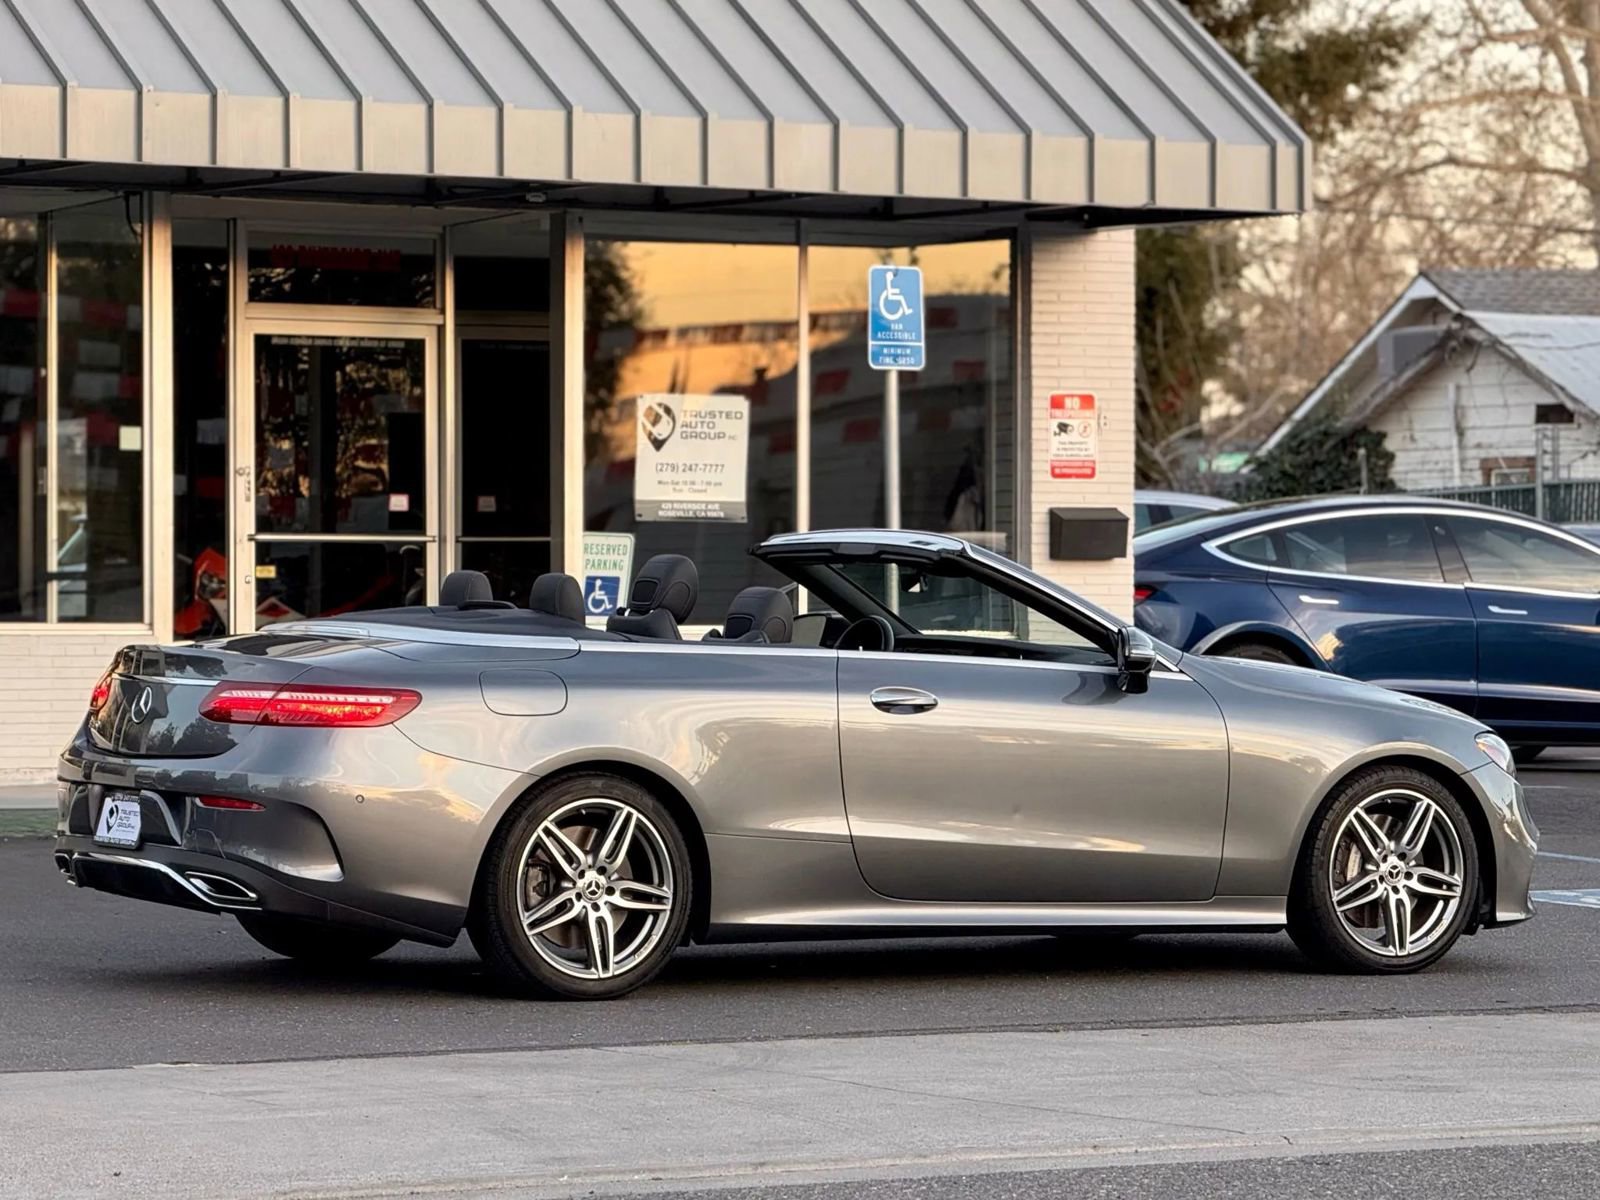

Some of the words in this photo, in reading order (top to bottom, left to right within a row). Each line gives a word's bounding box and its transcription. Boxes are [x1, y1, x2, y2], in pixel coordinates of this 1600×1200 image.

[877, 331, 916, 340] ACCESSIBLE
[1064, 396, 1080, 409] NO
[681, 410, 744, 420] TRUSTED
[680, 420, 716, 430] AUTO
[680, 430, 726, 440] GROUP
[655, 462, 679, 474] (279)
[682, 463, 725, 473] 247-7777
[583, 543, 628, 556] RESERVED
[585, 558, 624, 571] PARKING
